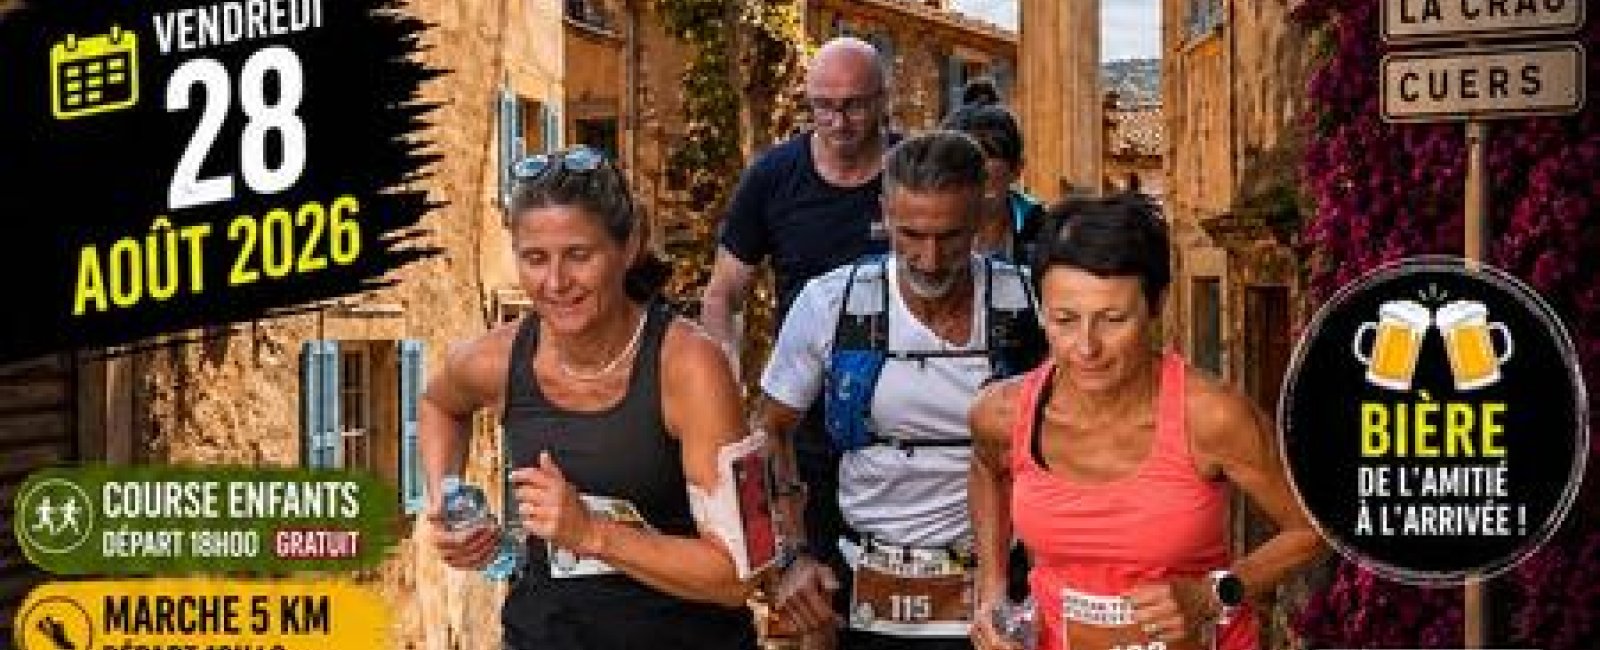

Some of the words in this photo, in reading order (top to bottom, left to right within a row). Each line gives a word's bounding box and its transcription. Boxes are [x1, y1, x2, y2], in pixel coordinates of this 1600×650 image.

[1399, 0, 1442, 24] LA
[1400, 65, 1543, 102] CUERS
[888, 595, 934, 622] 115
